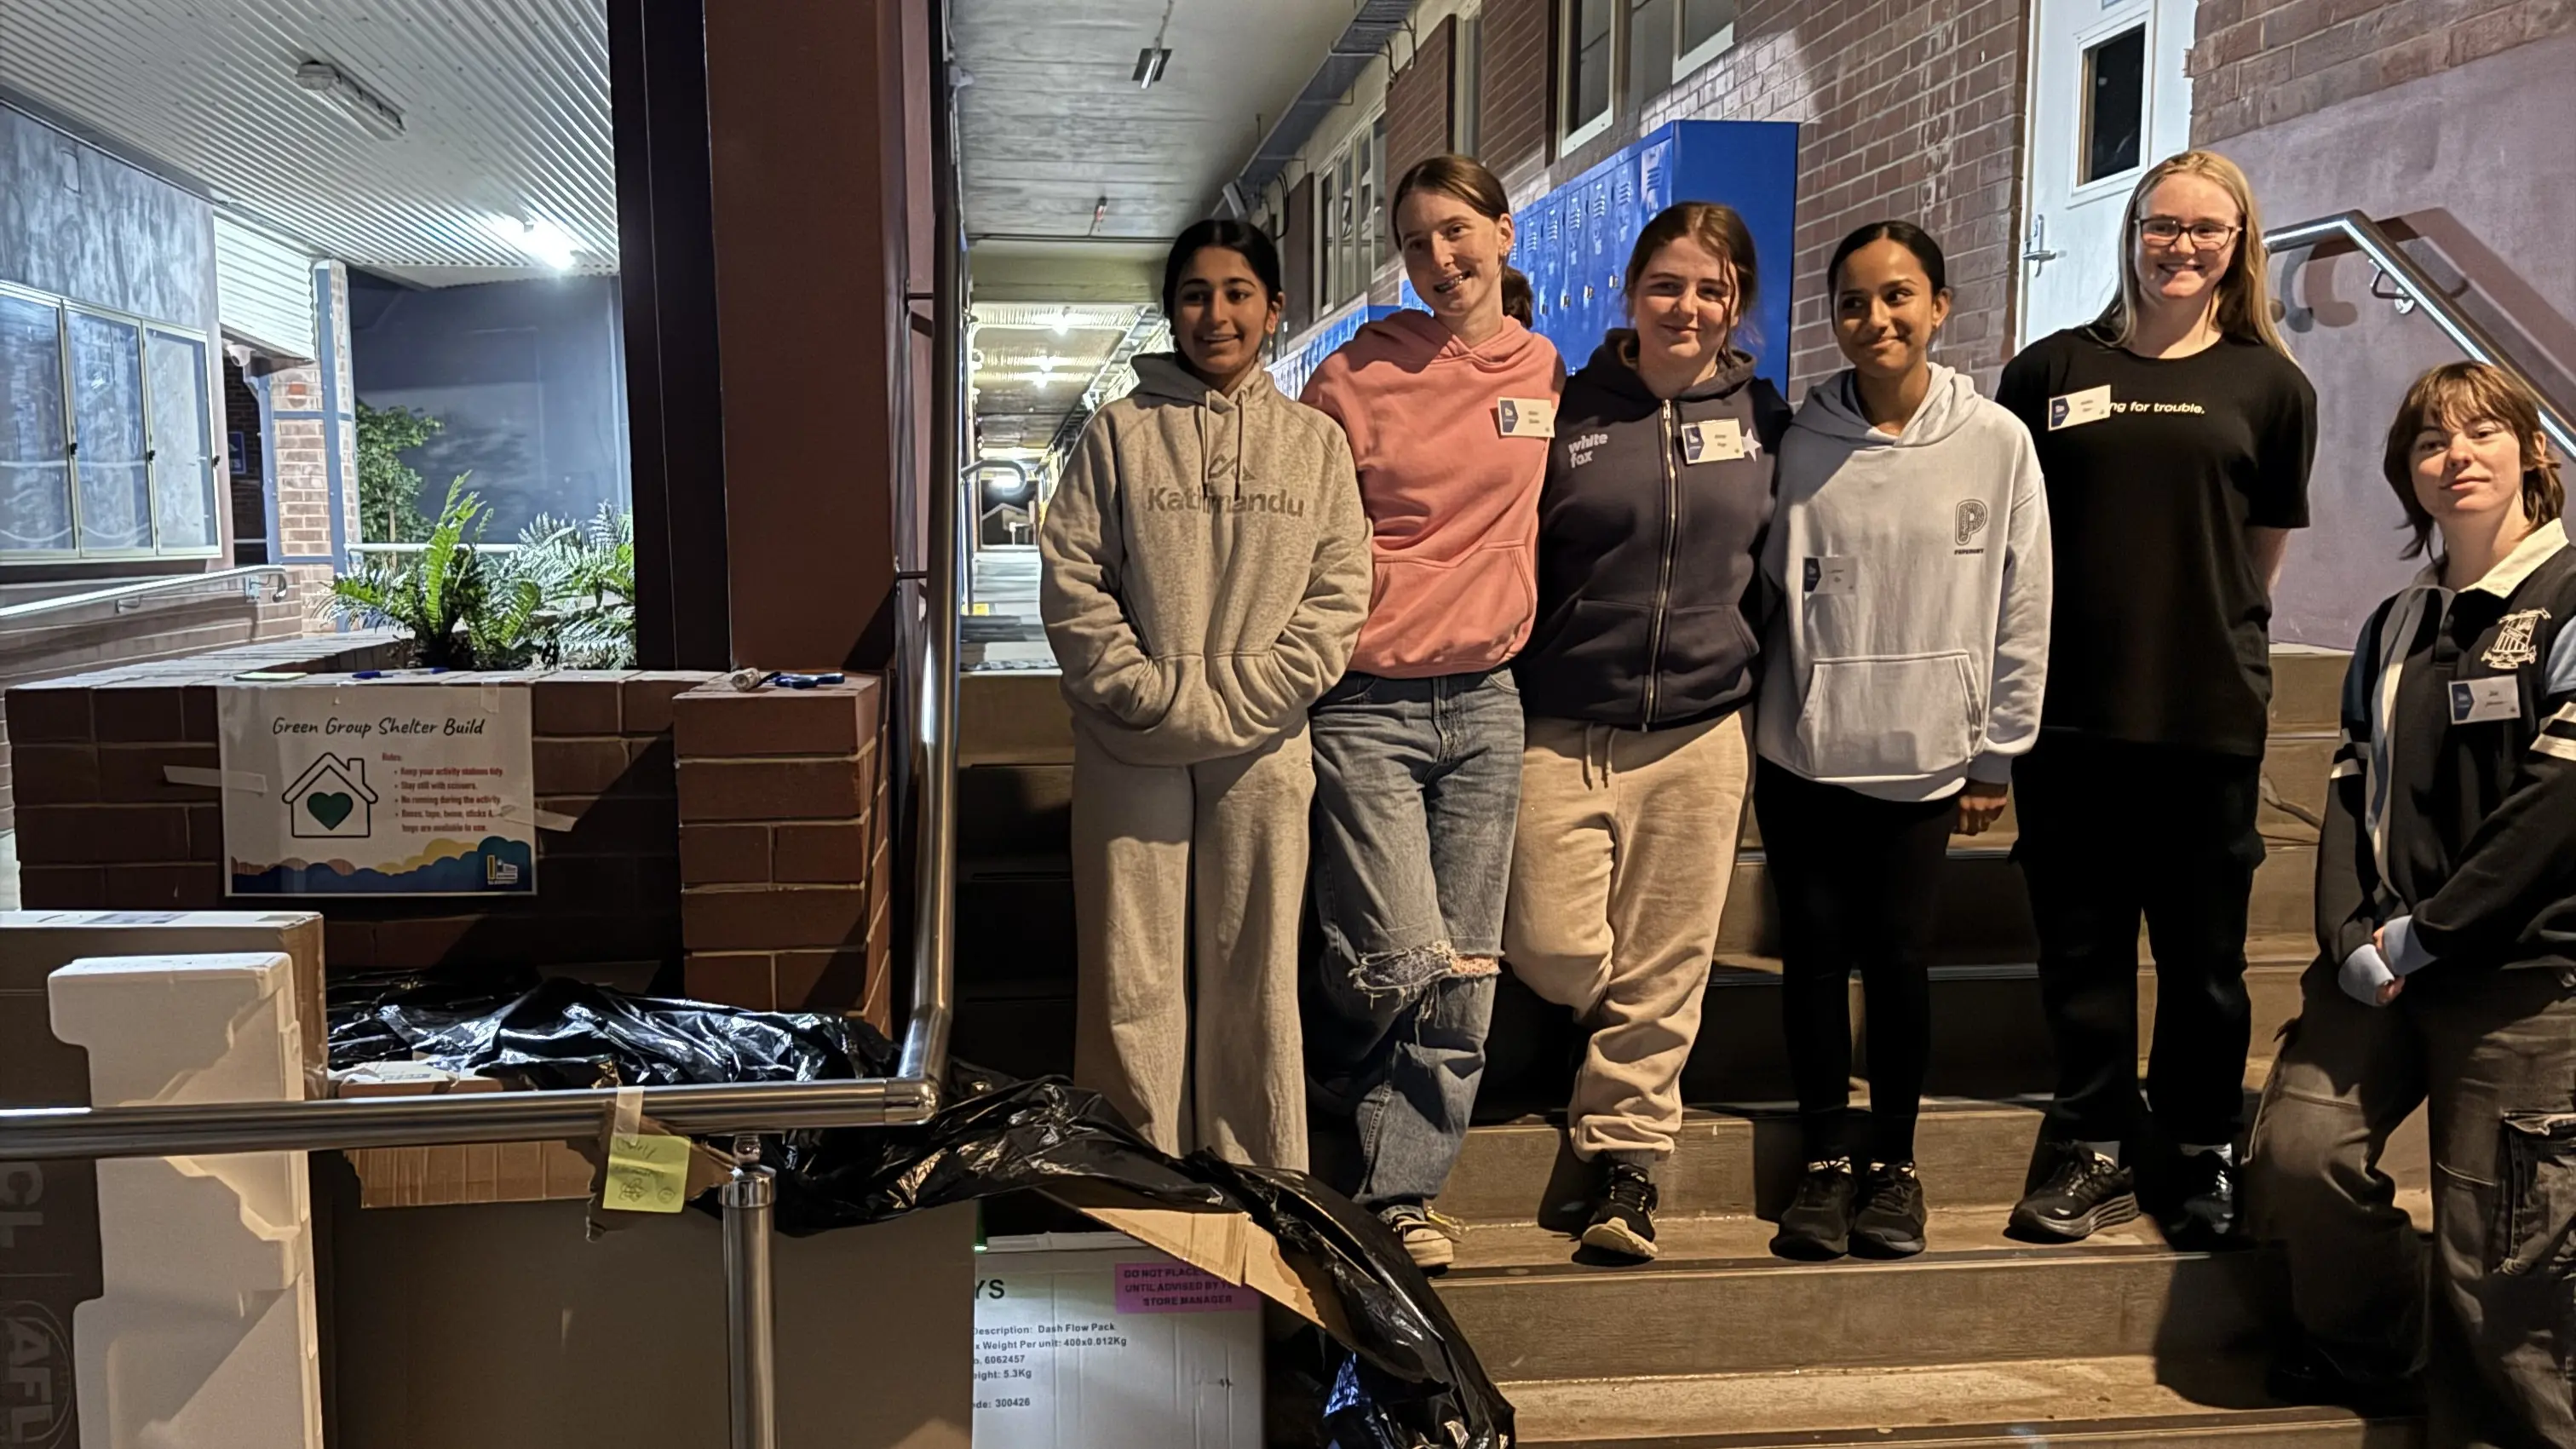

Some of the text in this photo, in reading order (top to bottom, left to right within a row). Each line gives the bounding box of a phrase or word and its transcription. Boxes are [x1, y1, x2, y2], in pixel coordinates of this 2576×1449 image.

[2130, 400, 2150, 412] for
[2153, 402, 2205, 415] trouble.
[1568, 434, 1608, 455] white
[1570, 451, 1593, 469] fox
[272, 716, 486, 739] Green Group Shelter Build
[400, 768, 418, 777] Keep
[419, 768, 434, 778] your
[435, 768, 461, 777] activity
[400, 781, 416, 791] Stay
[417, 781, 429, 790] still
[431, 781, 446, 790] with
[400, 795, 411, 804] No
[412, 796, 439, 806] running
[440, 796, 462, 806] during
[463, 796, 474, 804] the
[466, 809, 486, 818] sticks
[433, 823, 463, 832] available
[1124, 1269, 1140, 1279] DO
[1141, 1268, 1163, 1279] NOT
[1124, 1283, 1156, 1293] UNTIL
[1157, 1281, 1203, 1292] ADVISED
[1205, 1281, 1219, 1291] BY
[1143, 1295, 1233, 1307] STORE MANAGER
[1038, 1325, 1063, 1334] Dash
[1066, 1324, 1089, 1333] Flow
[1091, 1322, 1115, 1331] Pack
[982, 1340, 1017, 1351] Weight
[1020, 1340, 1037, 1348] Per
[1038, 1339, 1061, 1348] unit:
[1063, 1337, 1127, 1348] 400x0.012Kg
[984, 1354, 1026, 1365] 6062457
[1003, 1369, 1032, 1379] 5.3Kg
[7, 1317, 53, 1444] AFL
[995, 1397, 1031, 1407] 300426
